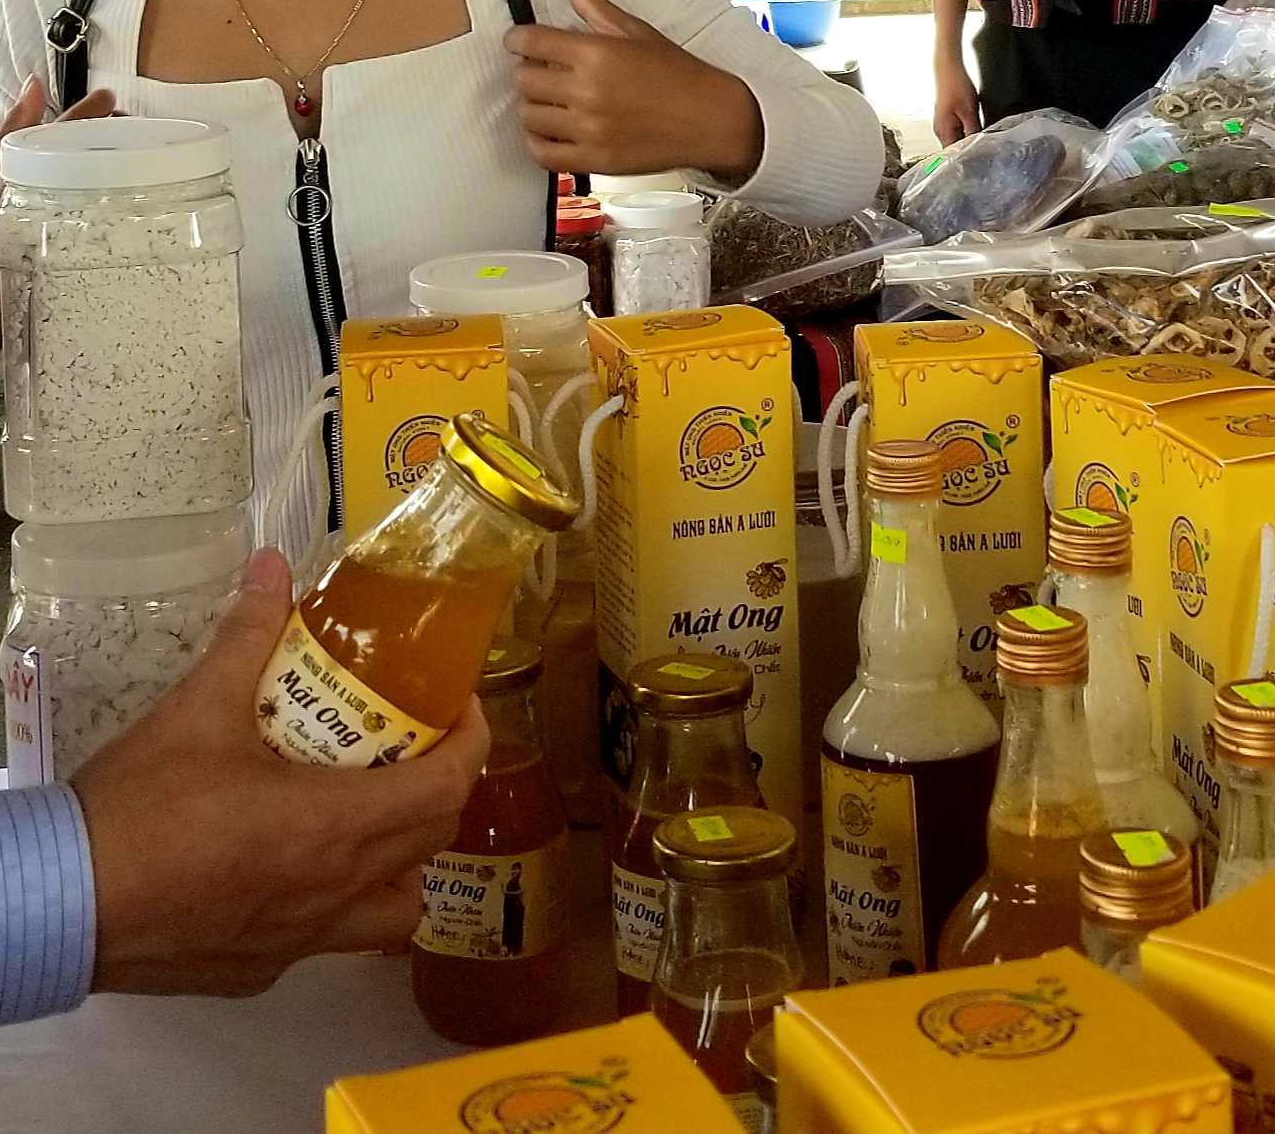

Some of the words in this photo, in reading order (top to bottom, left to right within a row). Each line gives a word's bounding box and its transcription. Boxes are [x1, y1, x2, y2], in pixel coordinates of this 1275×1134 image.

[680, 451, 736, 481] NGỌC
[739, 440, 766, 462] SU
[982, 457, 1012, 479] SU
[673, 518, 705, 539] NÔNG
[709, 514, 734, 535] SẢN
[737, 514, 745, 532] A
[748, 510, 777, 530] LƯỚI
[949, 533, 975, 552] SẢN
[980, 533, 989, 550] A
[992, 531, 1022, 550] LƯỚI
[668, 607, 723, 642] Mật
[727, 603, 785, 633] Ong
[754, 660, 781, 675] Chất
[277, 668, 321, 711] Mật
[315, 707, 363, 748] Ong
[337, 687, 345, 699] A
[1172, 734, 1194, 780] Mật
[1195, 759, 1221, 810] Ong
[423, 873, 446, 897] ật
[449, 879, 487, 903] Ong
[830, 878, 855, 908] Mật
[859, 891, 901, 918] Ong
[614, 892, 631, 917] ật
[634, 902, 665, 929] Ong
